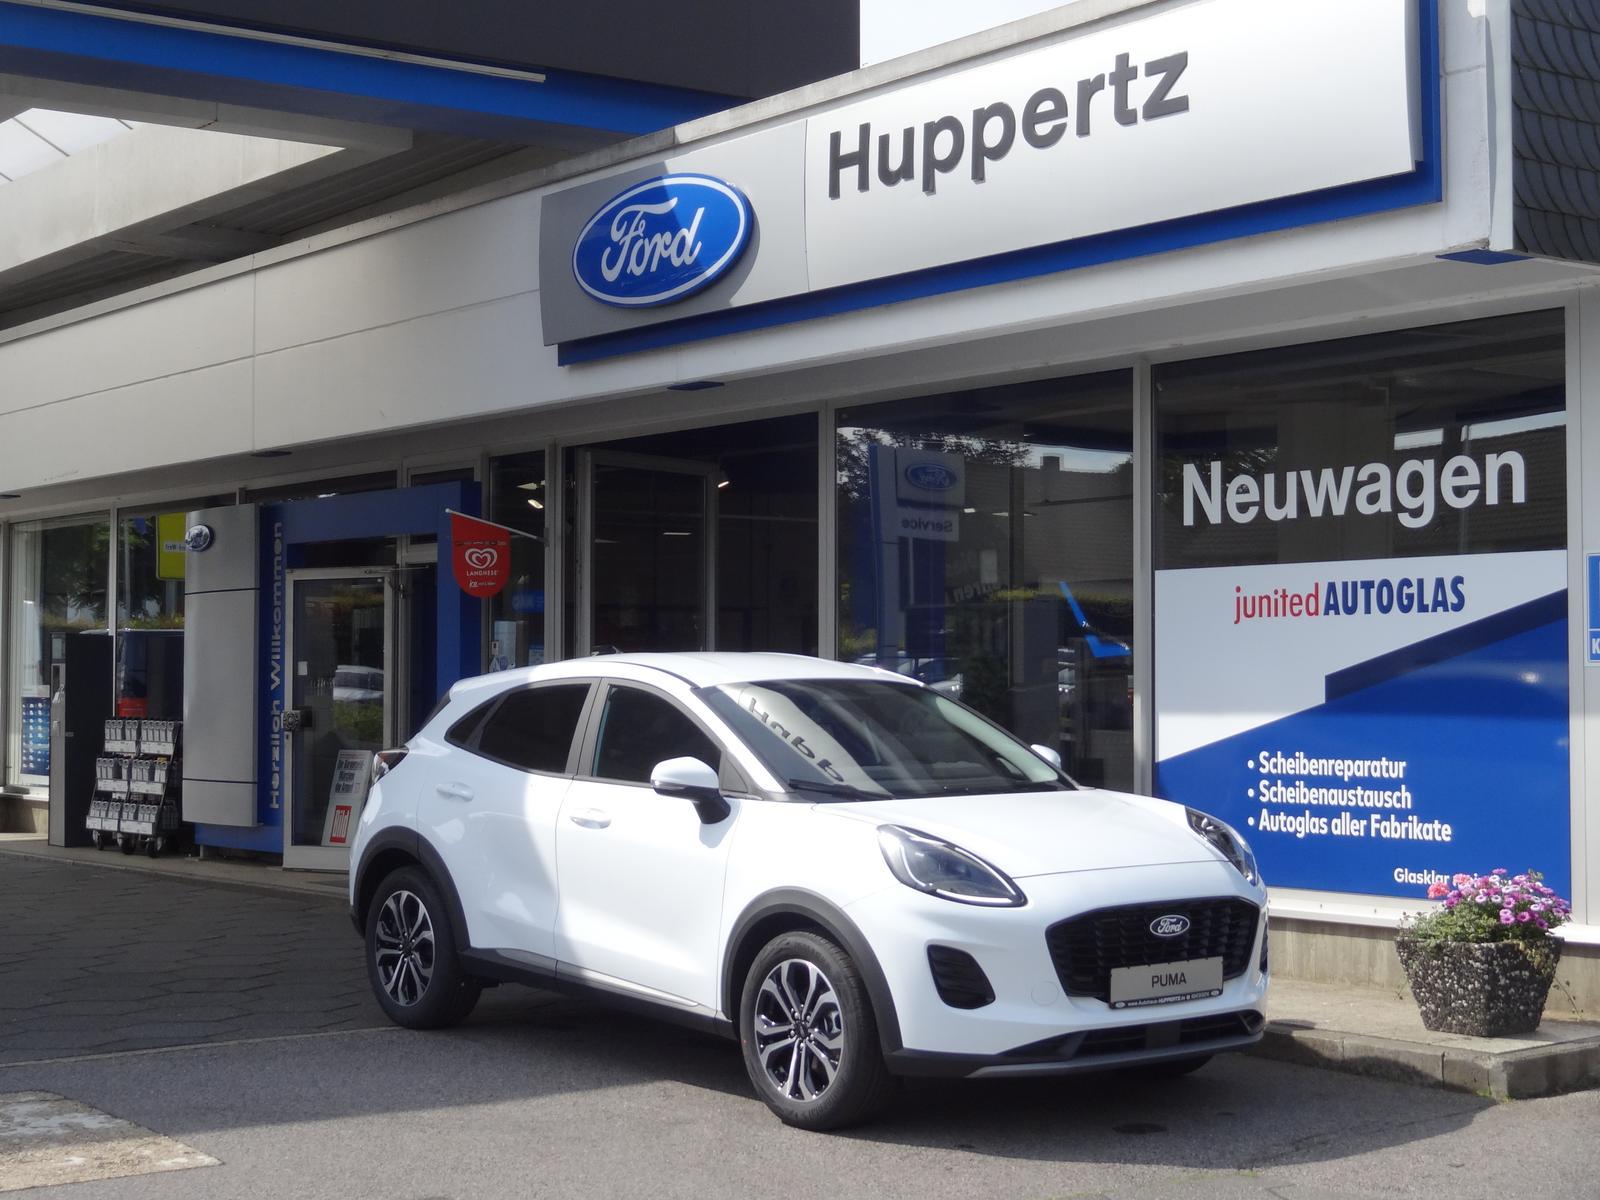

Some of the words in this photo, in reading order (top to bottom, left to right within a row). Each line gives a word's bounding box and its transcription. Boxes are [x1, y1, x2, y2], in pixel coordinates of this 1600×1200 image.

[828, 51, 1189, 199] Huppertz
[601, 196, 705, 282] Ford
[1182, 450, 1526, 529] Neuwagen
[270, 521, 283, 691] Willkommen
[269, 699, 281, 809] Herzlich
[1258, 751, 1407, 782] Scheibenreparatur
[1258, 779, 1412, 809] Scheibenaustausch
[1258, 808, 1328, 839] Autoglas
[1331, 812, 1368, 837] aller
[1370, 814, 1452, 842] Fabrikate
[1393, 867, 1450, 885] Glasklar
[1157, 918, 1183, 934] Ford
[1151, 972, 1187, 988] PUMA
